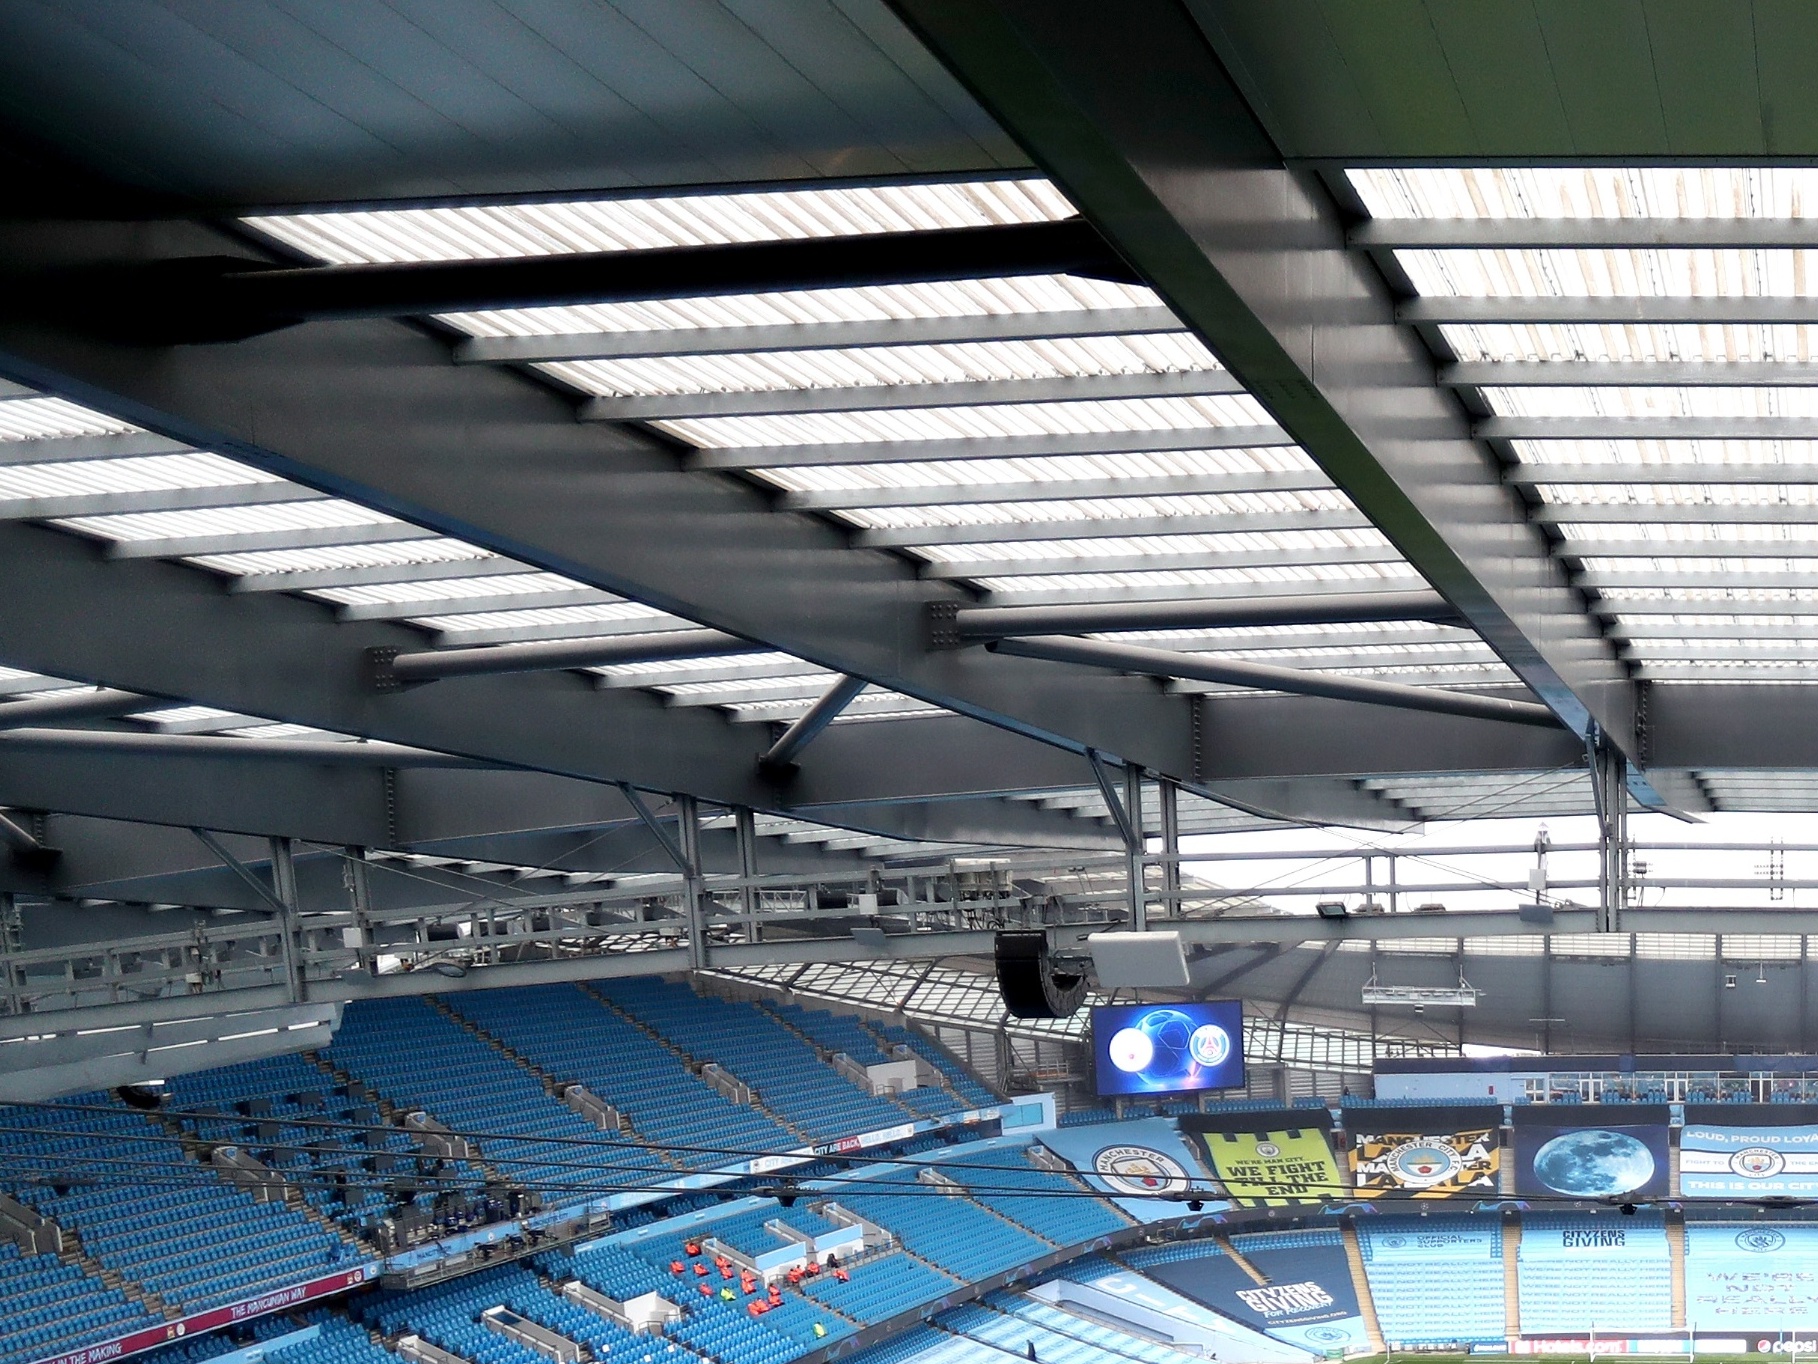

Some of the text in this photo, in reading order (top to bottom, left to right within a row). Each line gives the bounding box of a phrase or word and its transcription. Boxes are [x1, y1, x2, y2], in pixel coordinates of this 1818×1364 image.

[1686, 1131, 1728, 1143] LOUD,
[1731, 1135, 1782, 1143] PROUD
[1100, 1147, 1165, 1172] MANCHESTER
[1264, 1157, 1283, 1165] MAN
[1285, 1156, 1305, 1164] CITY
[1388, 1142, 1433, 1172] MANCHESTER
[1438, 1144, 1457, 1158] CITY
[1734, 1149, 1780, 1160] MANCHESTER
[1226, 1161, 1325, 1177] WE FIGHT
[1291, 1172, 1329, 1184] THE
[1266, 1184, 1310, 1195] END
[1688, 1181, 1726, 1190] THIS
[1729, 1182, 1745, 1190] IS
[1748, 1182, 1785, 1190] OUR
[1562, 1230, 1625, 1238] CITYZENS
[1563, 1237, 1626, 1247] GIVING
[1235, 1281, 1324, 1301] CITYZENS
[230, 1286, 307, 1319] THE MANCUNIAN WAY
[1246, 1287, 1334, 1312] GIVING
[1533, 1340, 1623, 1354] Hotels.com
[1773, 1340, 1817, 1353] pepsi
